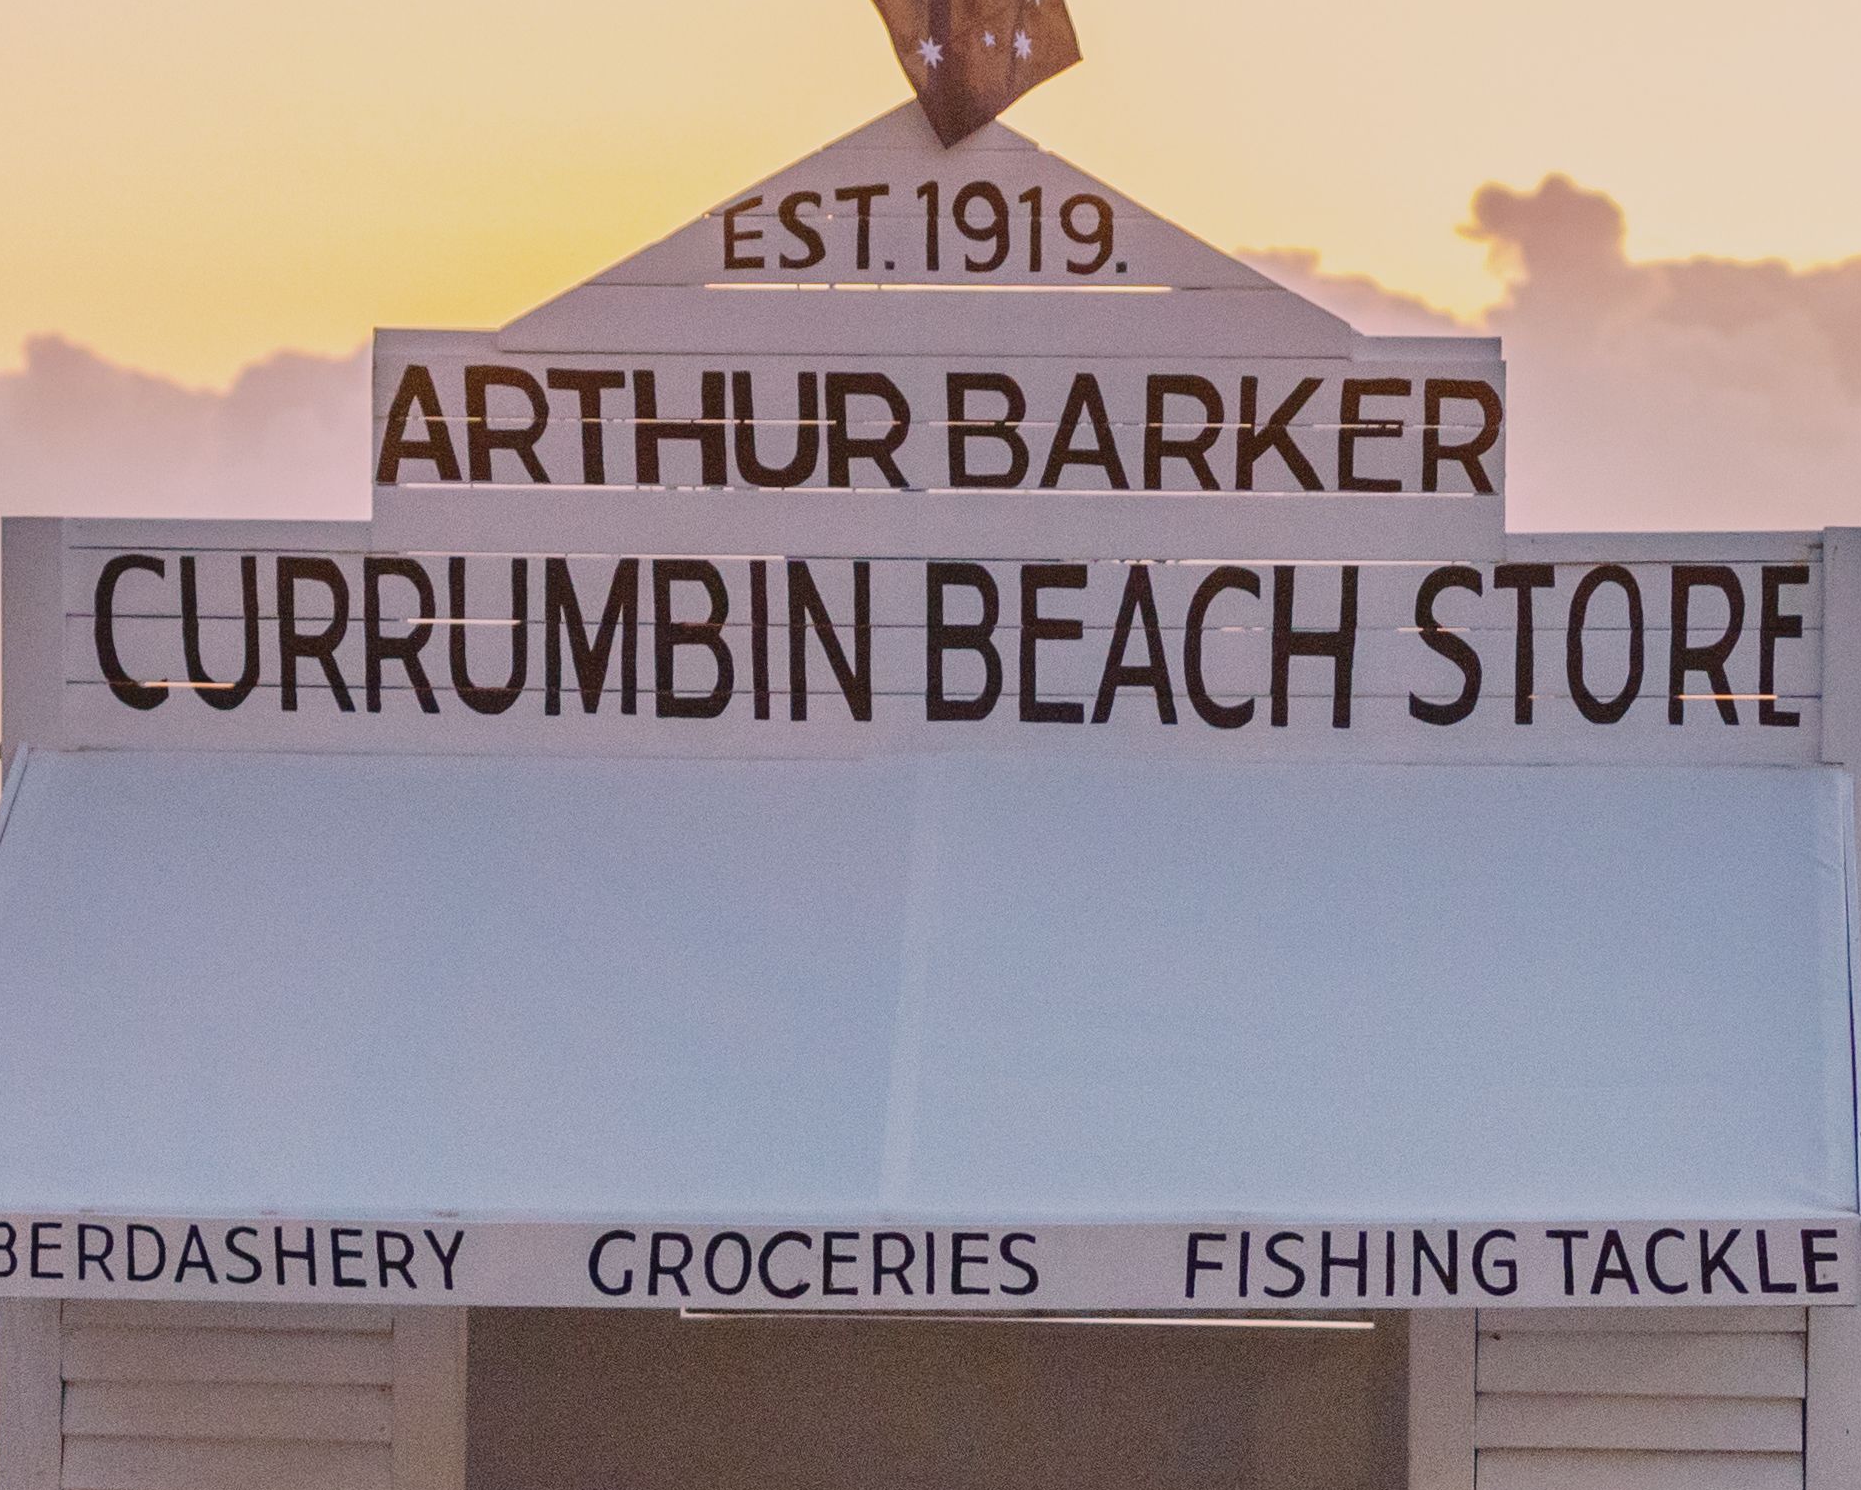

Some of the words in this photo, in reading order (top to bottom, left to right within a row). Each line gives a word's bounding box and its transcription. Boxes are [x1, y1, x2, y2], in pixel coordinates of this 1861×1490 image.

[375, 364, 912, 488] ARTHUR
[946, 372, 1502, 495] BARKER
[93, 554, 873, 722] CURRUMBIN
[925, 560, 1359, 730] BEACH
[1408, 562, 1811, 728] STORE
[587, 1229, 1041, 1299] GROCERIES
[1184, 1228, 1519, 1299] FISHING
[1545, 1227, 1840, 1296] TACKLE
